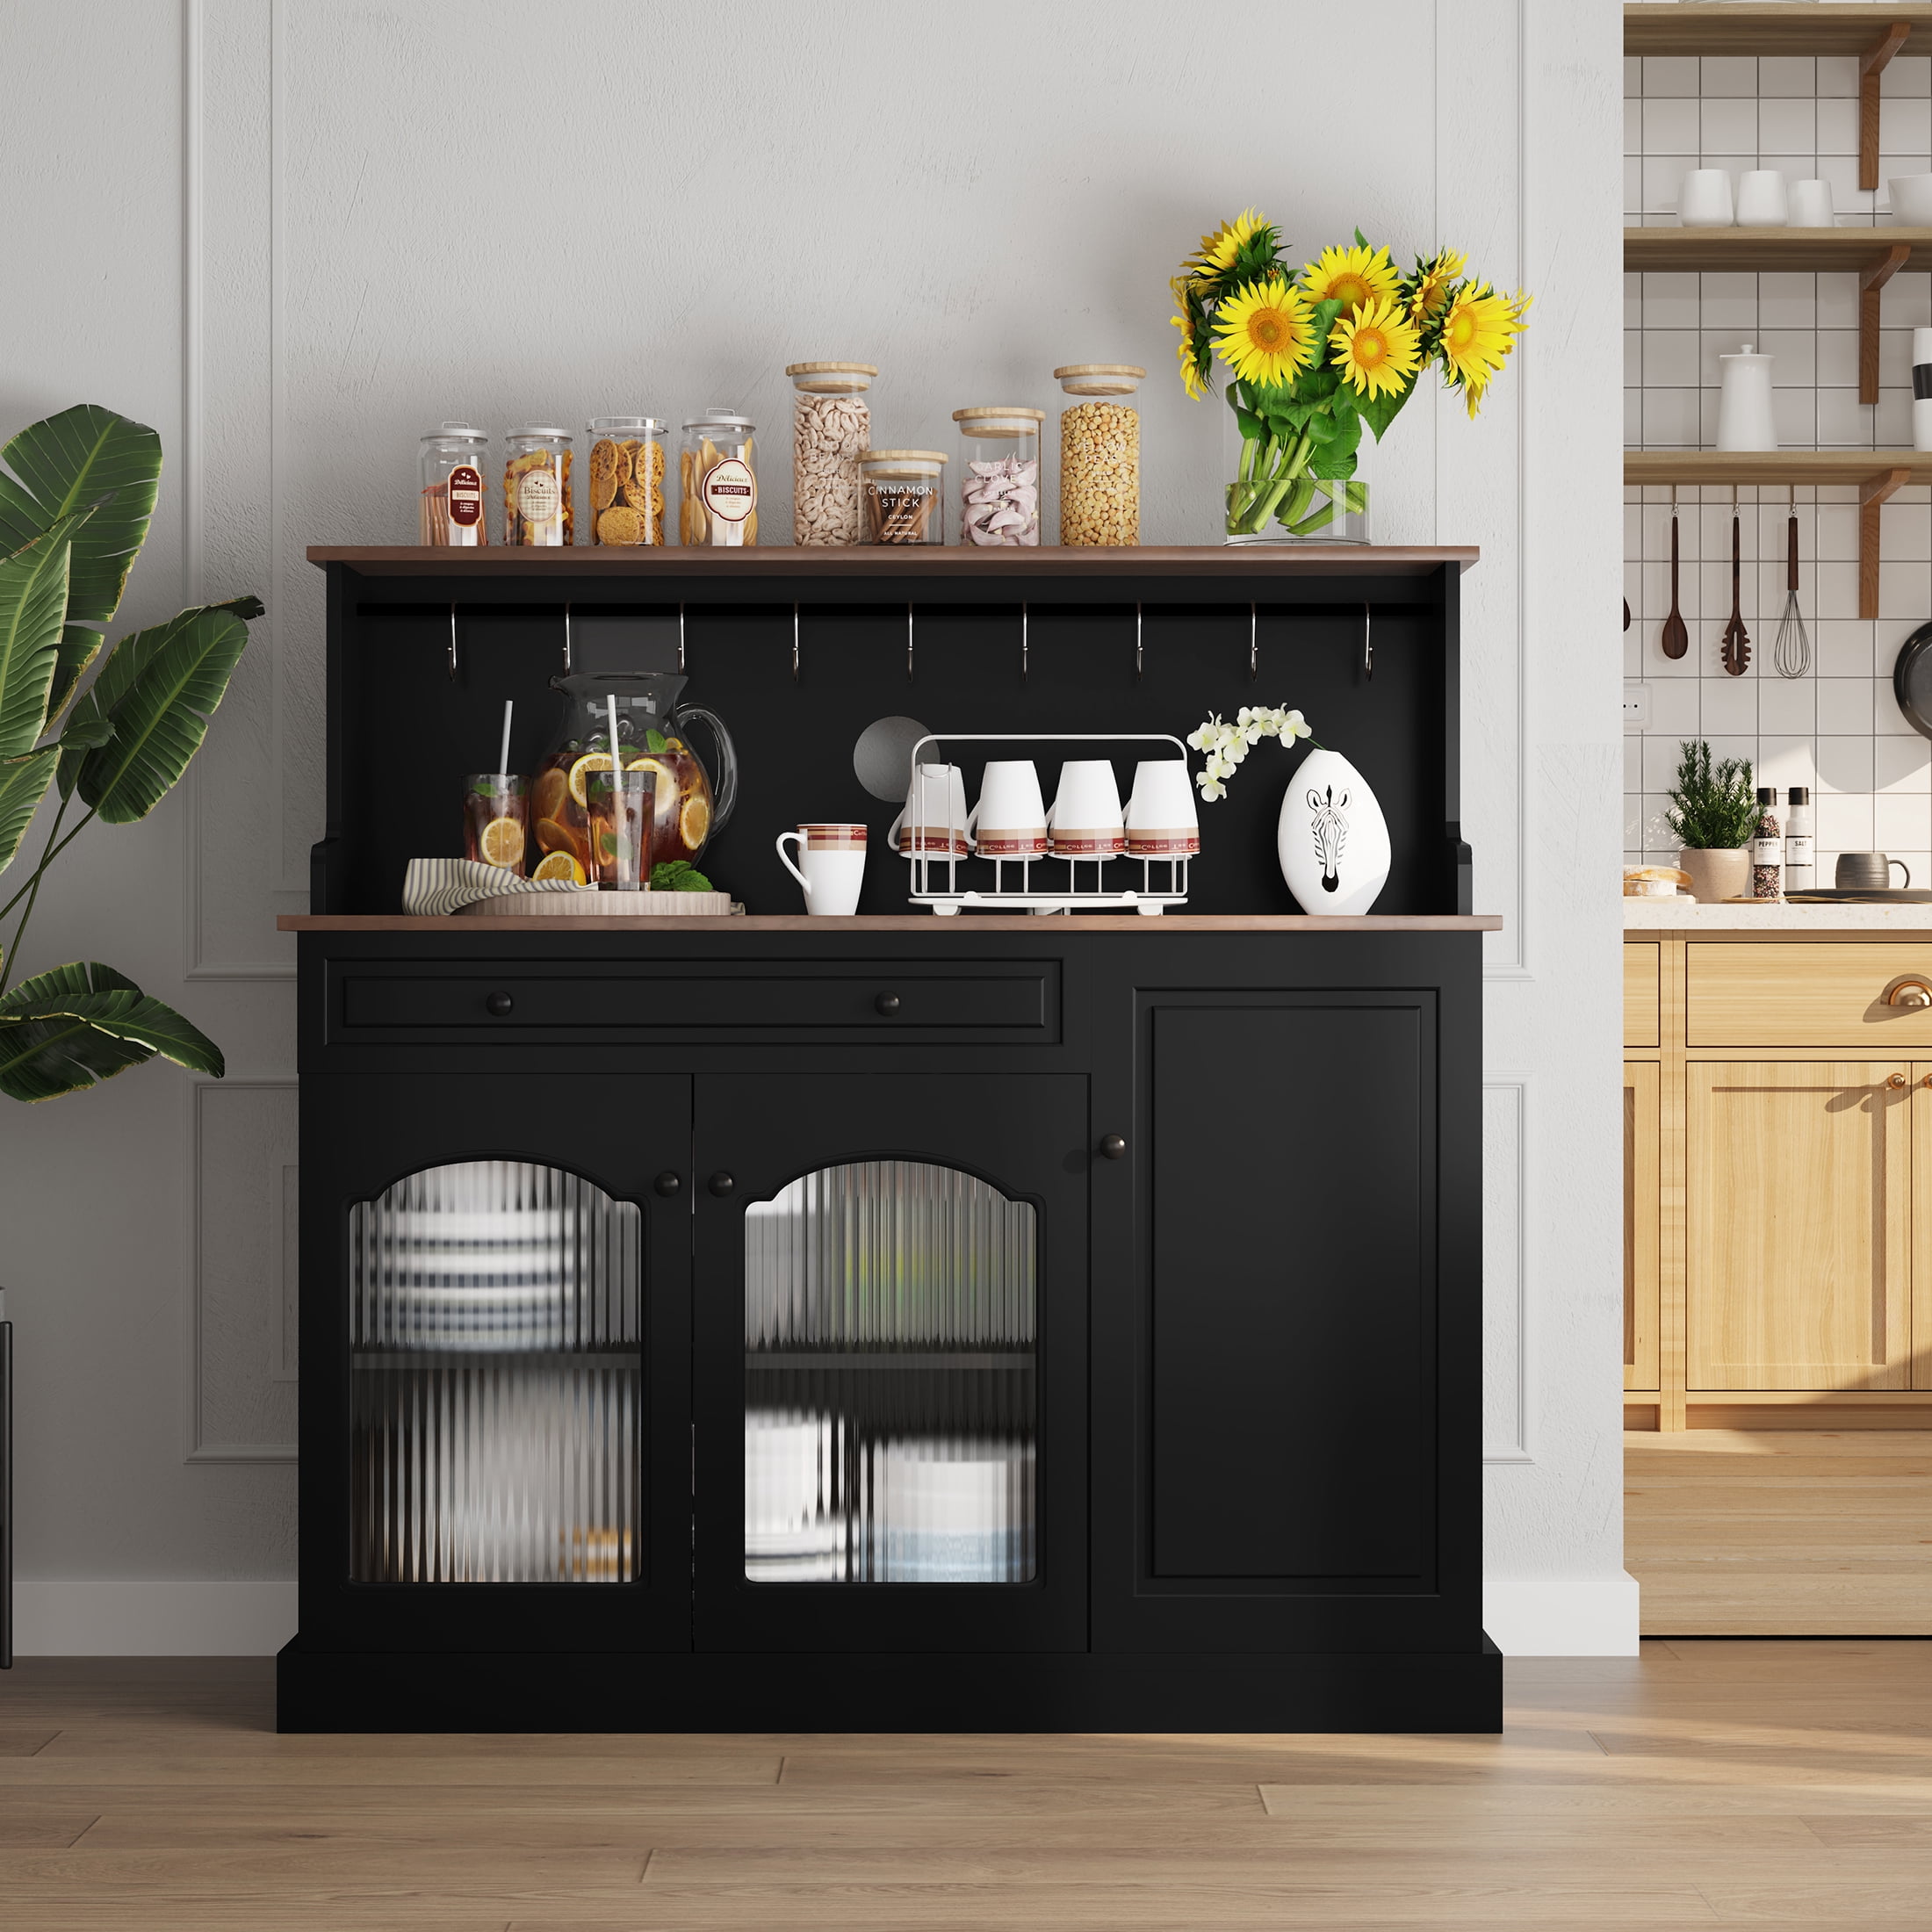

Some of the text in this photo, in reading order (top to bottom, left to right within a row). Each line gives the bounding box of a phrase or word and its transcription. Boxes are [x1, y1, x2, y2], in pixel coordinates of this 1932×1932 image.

[1074, 443, 1127, 451] YELLOW
[1085, 455, 1118, 464] PEAS
[868, 486, 933, 495] CINNAMON
[882, 498, 919, 508] STICK
